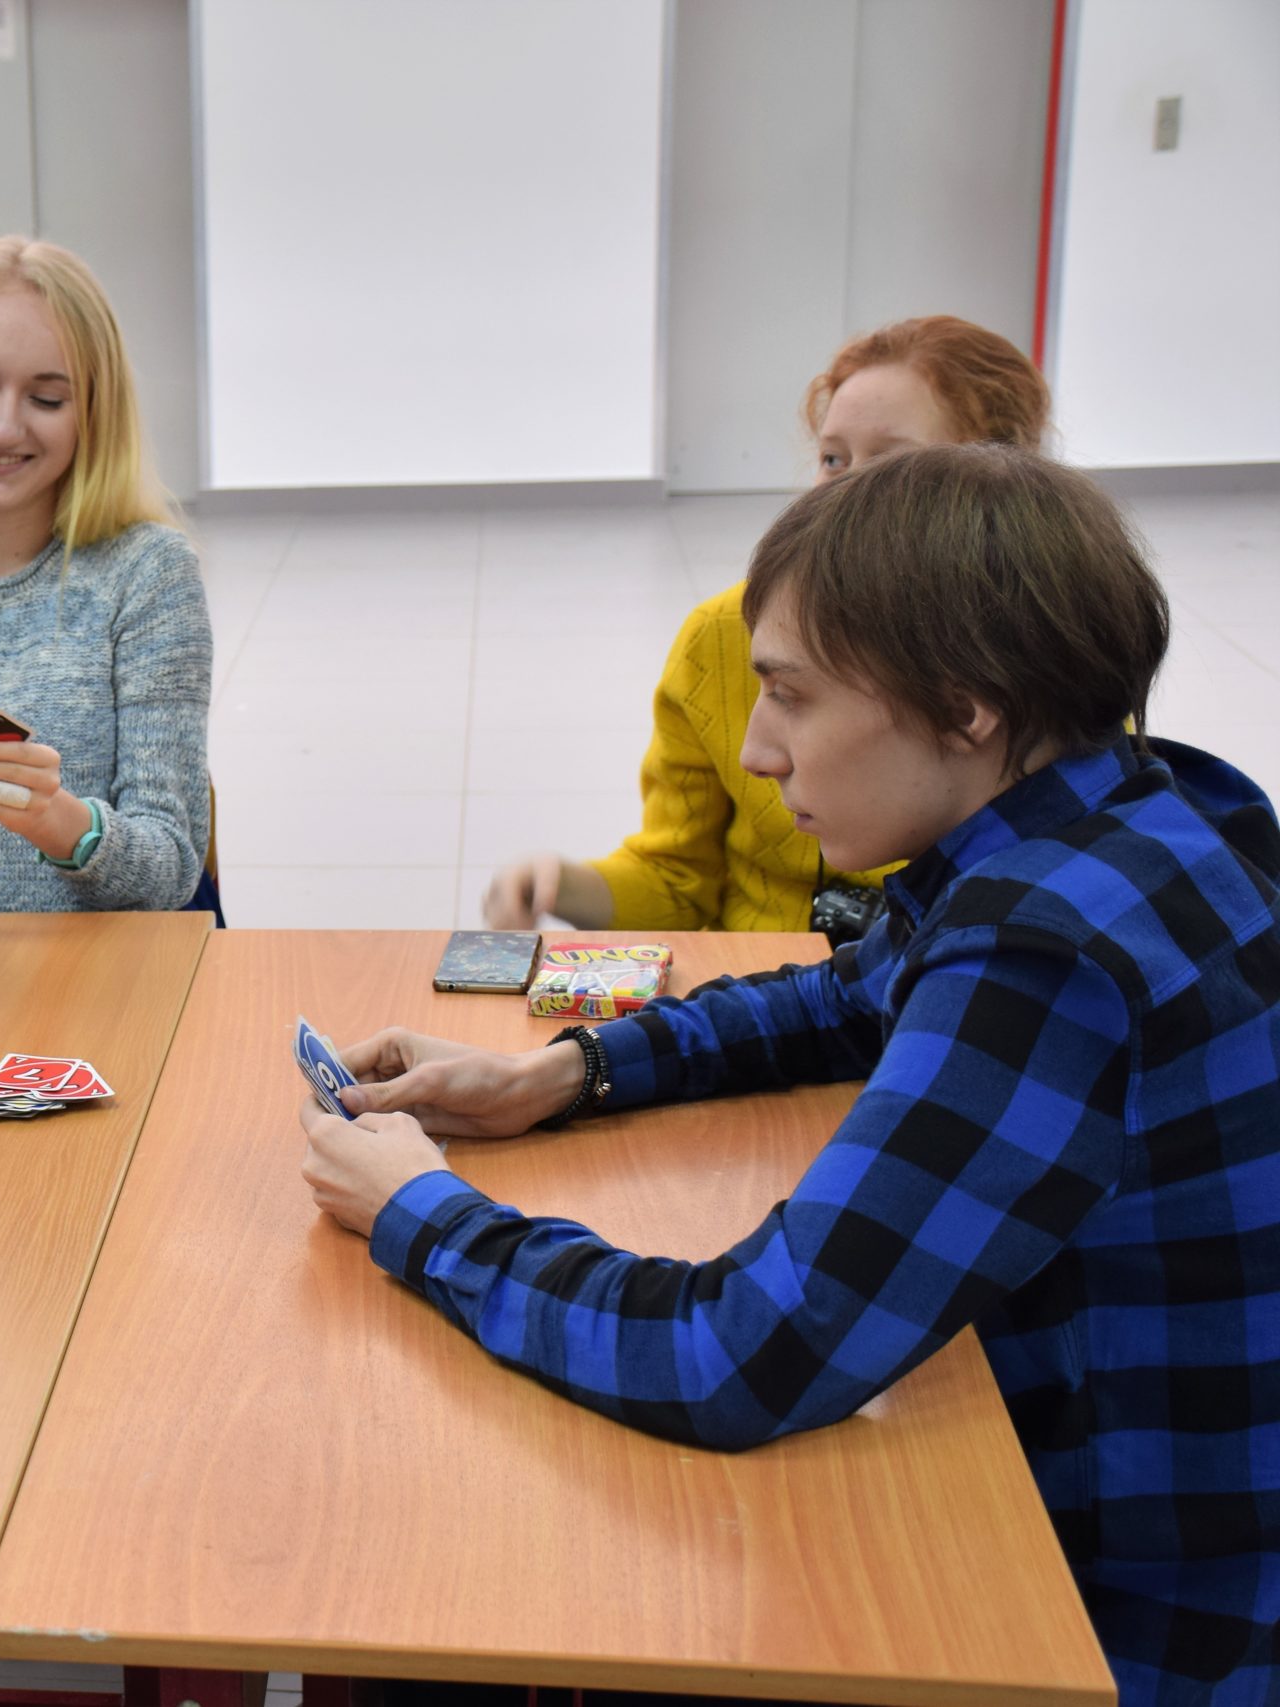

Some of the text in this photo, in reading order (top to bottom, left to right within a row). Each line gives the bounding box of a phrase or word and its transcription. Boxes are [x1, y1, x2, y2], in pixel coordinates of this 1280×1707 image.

[545, 944, 671, 966] UNO
[530, 992, 576, 1016] UNO
[12, 1068, 44, 1080] 7
